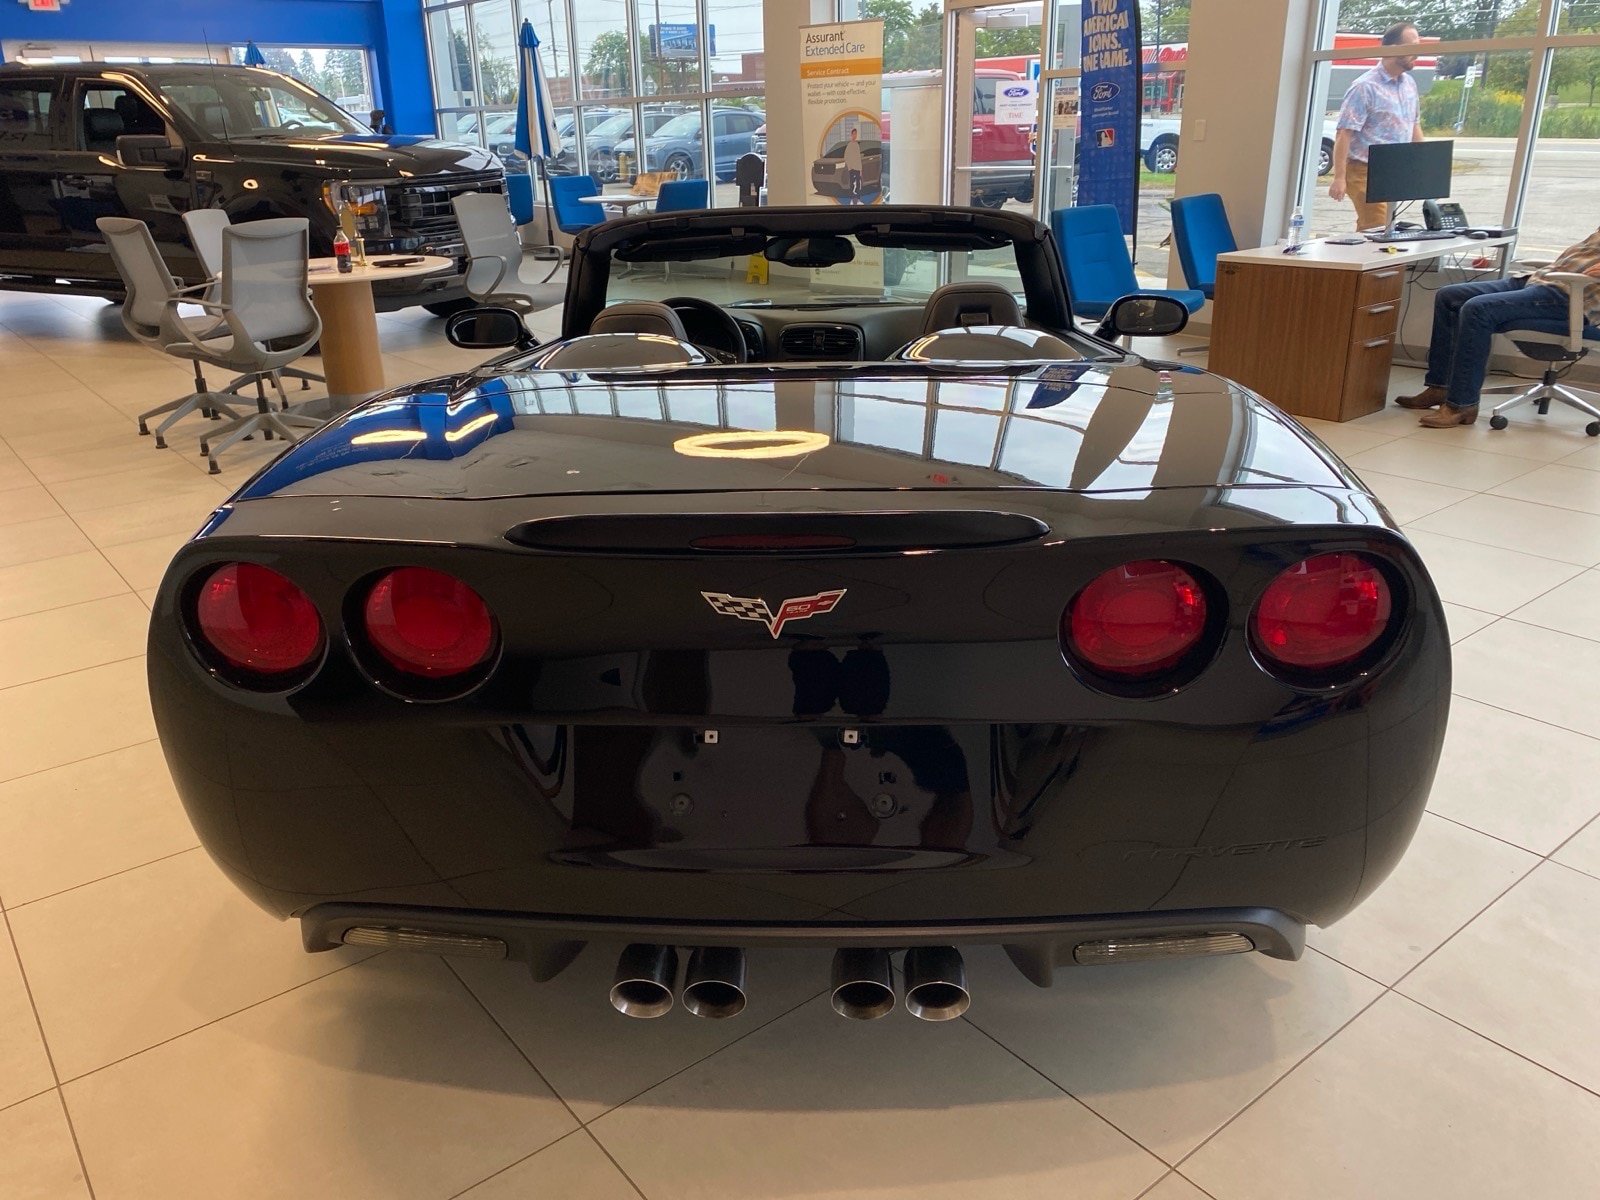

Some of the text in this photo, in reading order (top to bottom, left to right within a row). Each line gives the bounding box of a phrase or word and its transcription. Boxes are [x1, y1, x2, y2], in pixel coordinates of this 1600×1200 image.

[806, 32, 844, 43] Assurant
[806, 43, 865, 56] Extended Care
